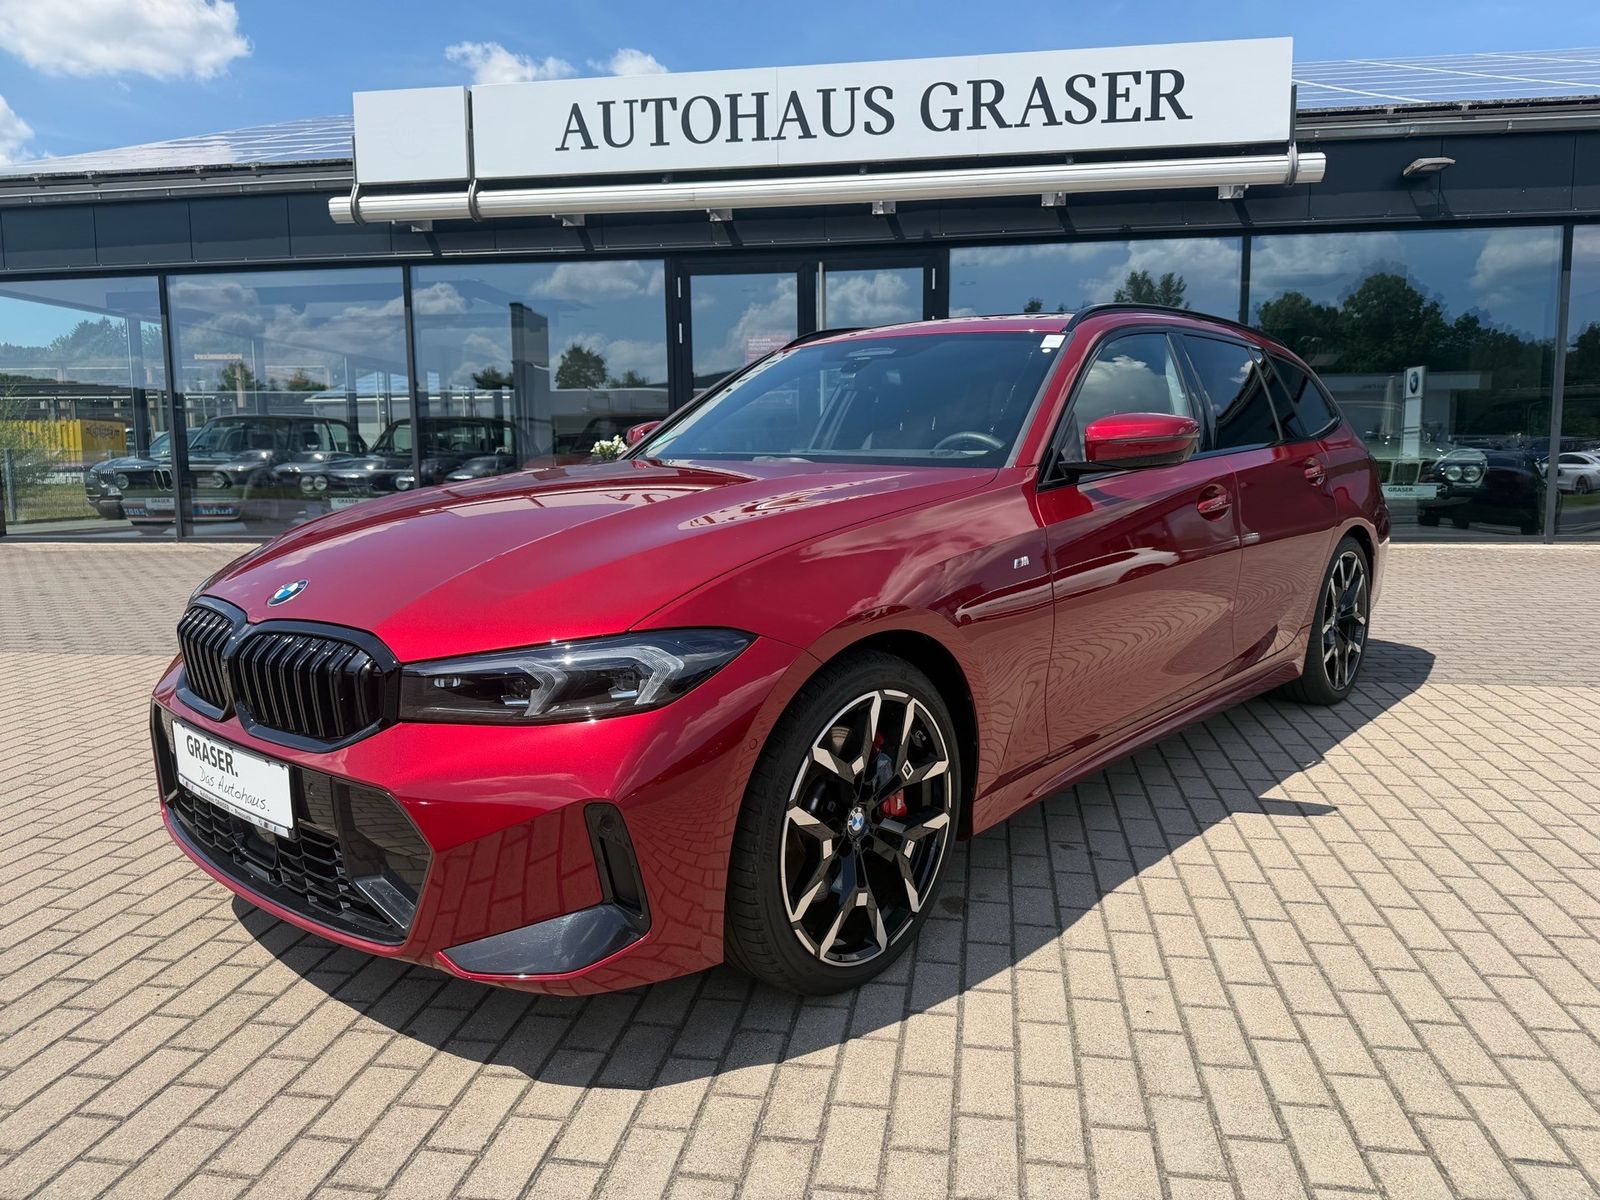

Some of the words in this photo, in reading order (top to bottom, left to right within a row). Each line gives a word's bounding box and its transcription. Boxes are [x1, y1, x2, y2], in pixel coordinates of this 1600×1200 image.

[555, 86, 895, 151] AUTOHAUS
[921, 69, 1193, 132] GRASER
[187, 735, 238, 777] GRASER.
[199, 766, 215, 787] Das
[218, 775, 270, 812] Autohaus.
